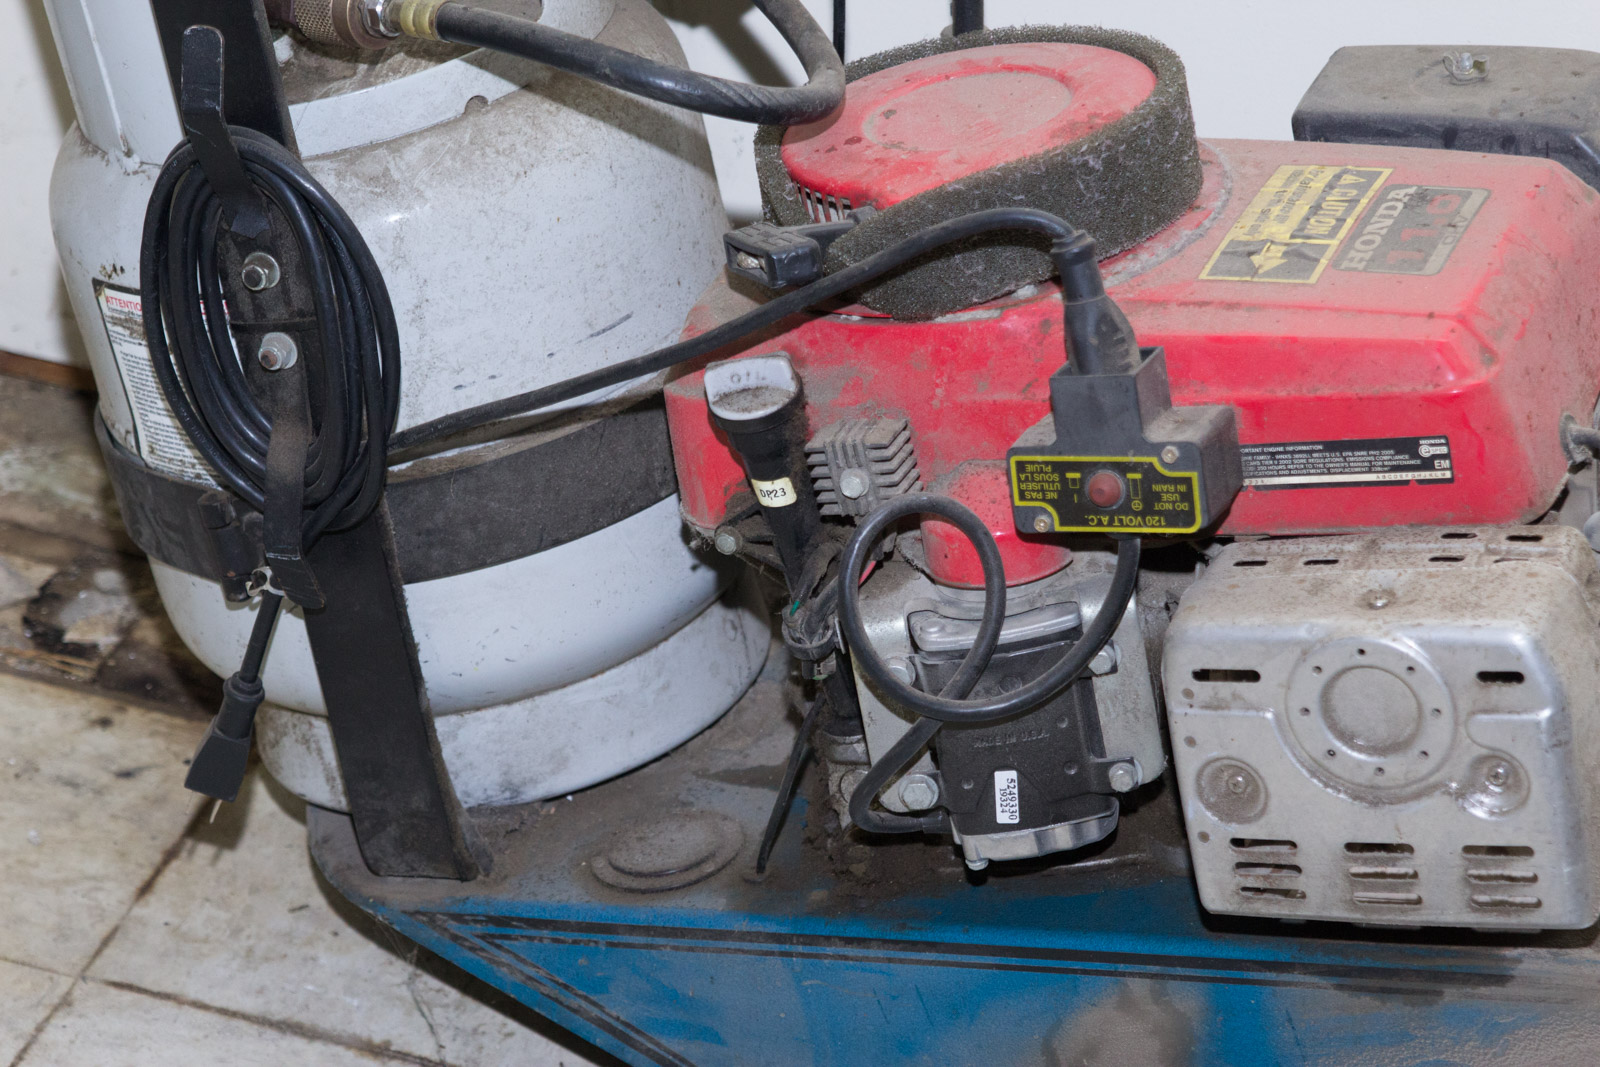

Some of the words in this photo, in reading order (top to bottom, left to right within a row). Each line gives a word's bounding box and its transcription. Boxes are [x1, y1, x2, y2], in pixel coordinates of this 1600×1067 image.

[1339, 186, 1418, 271] HONDA
[105, 295, 142, 312] ATTENTIO
[730, 371, 767, 384] OIL
[1025, 464, 1052, 473] PLUIE
[1434, 460, 1450, 469] EM
[1019, 472, 1031, 481] LA
[1032, 473, 1060, 482] SOUS
[1020, 482, 1061, 491] UTILISER
[1152, 483, 1175, 493] RAIN
[1176, 484, 1187, 493] IN
[1024, 491, 1043, 500] PAS
[1045, 491, 1058, 500] NE
[1161, 493, 1180, 502] USE
[1153, 502, 1173, 511] NOT
[1174, 502, 1189, 511] DO
[1084, 515, 1111, 526] A.C.
[1113, 515, 1144, 526] VOLT
[1145, 516, 1166, 527] 120
[999, 788, 1008, 814] 19324
[1007, 777, 1018, 820] 5249330
